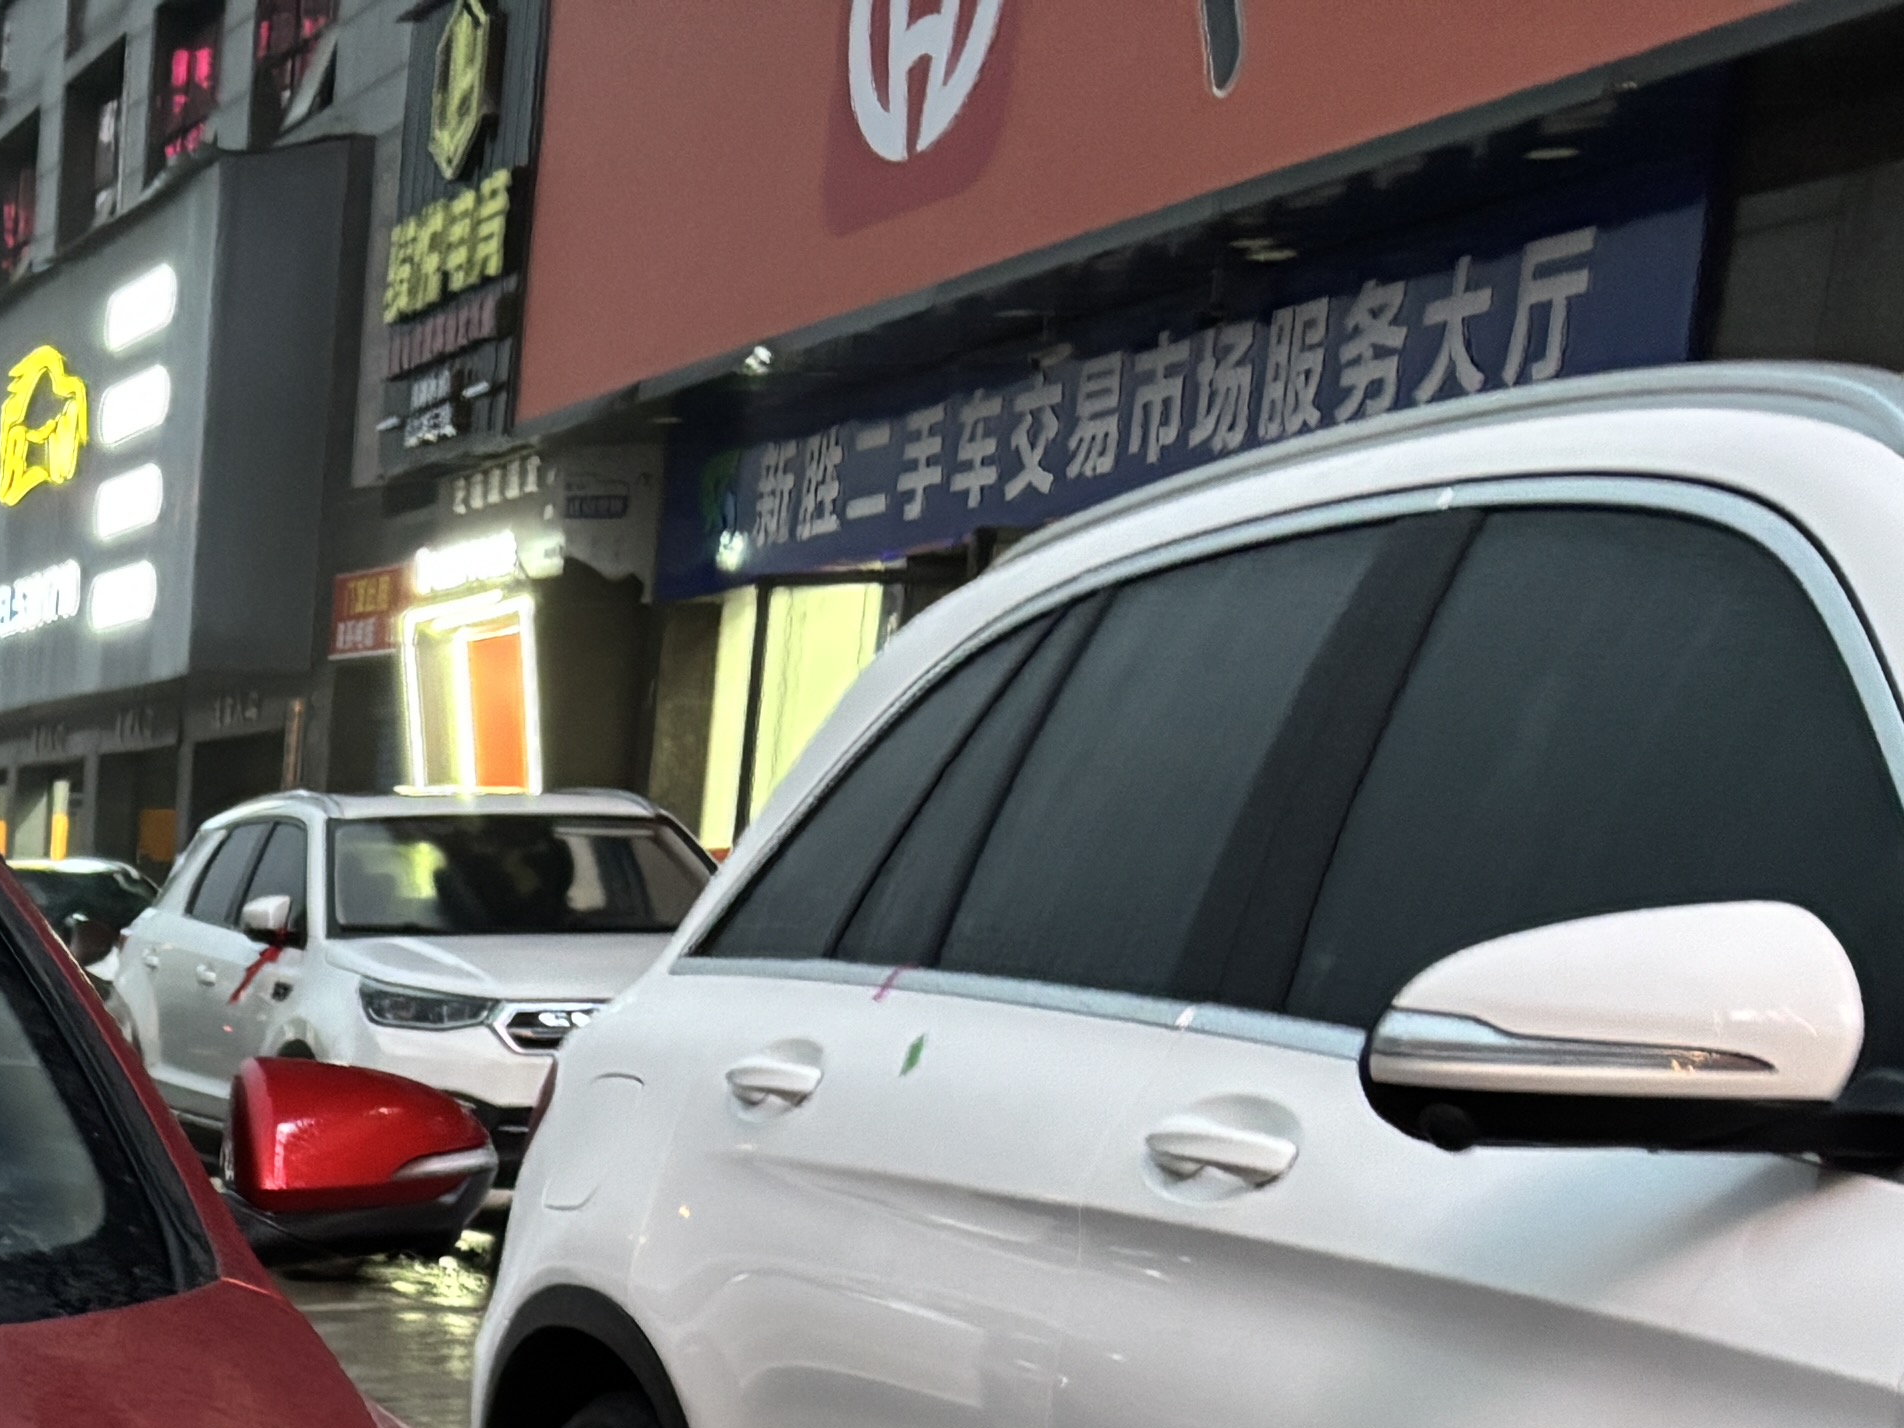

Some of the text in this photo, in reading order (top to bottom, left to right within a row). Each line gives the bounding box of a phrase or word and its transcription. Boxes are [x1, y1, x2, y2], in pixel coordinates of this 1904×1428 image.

[751, 227, 1597, 547] 新胜二手车交易市场服务大厅
